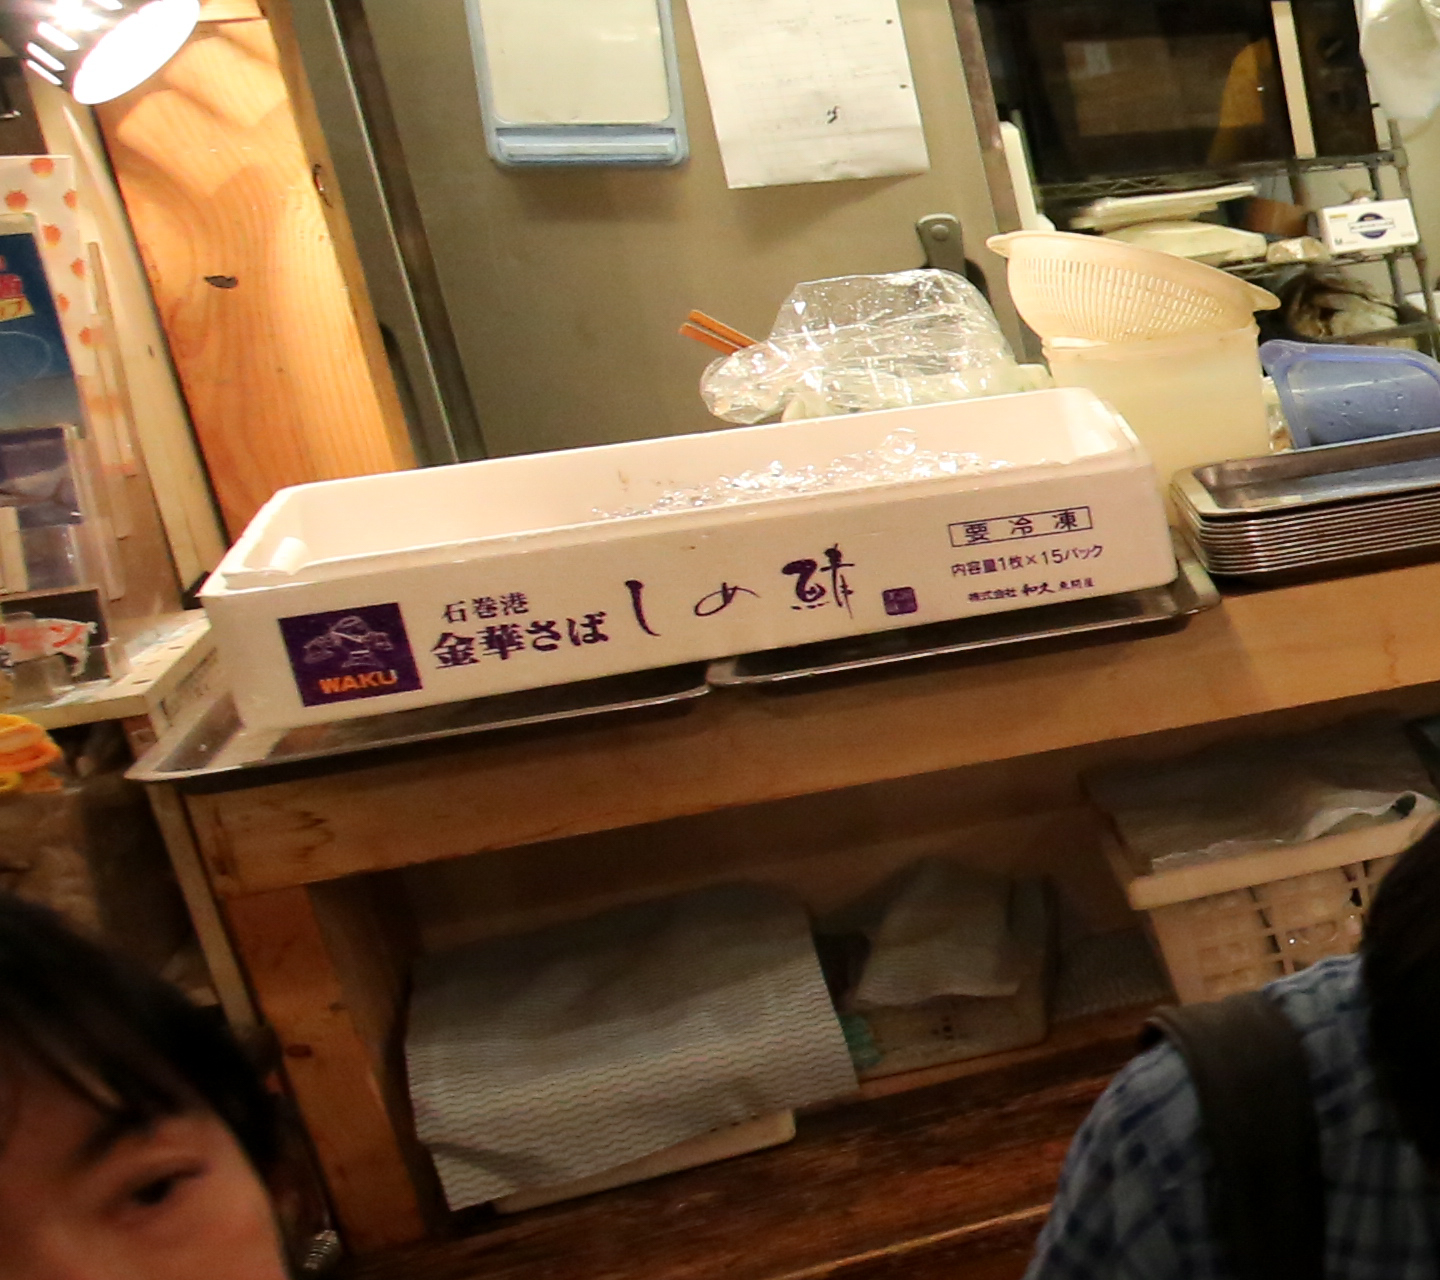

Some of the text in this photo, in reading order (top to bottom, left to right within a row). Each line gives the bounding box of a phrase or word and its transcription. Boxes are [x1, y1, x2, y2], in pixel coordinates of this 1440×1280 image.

[964, 512, 1079, 542] 要冷凍
[951, 544, 1104, 577] 内容量1枚×15パック
[441, 590, 530, 623] 石巻港
[431, 613, 607, 669] 金華さば
[320, 667, 397, 696] WAKU
